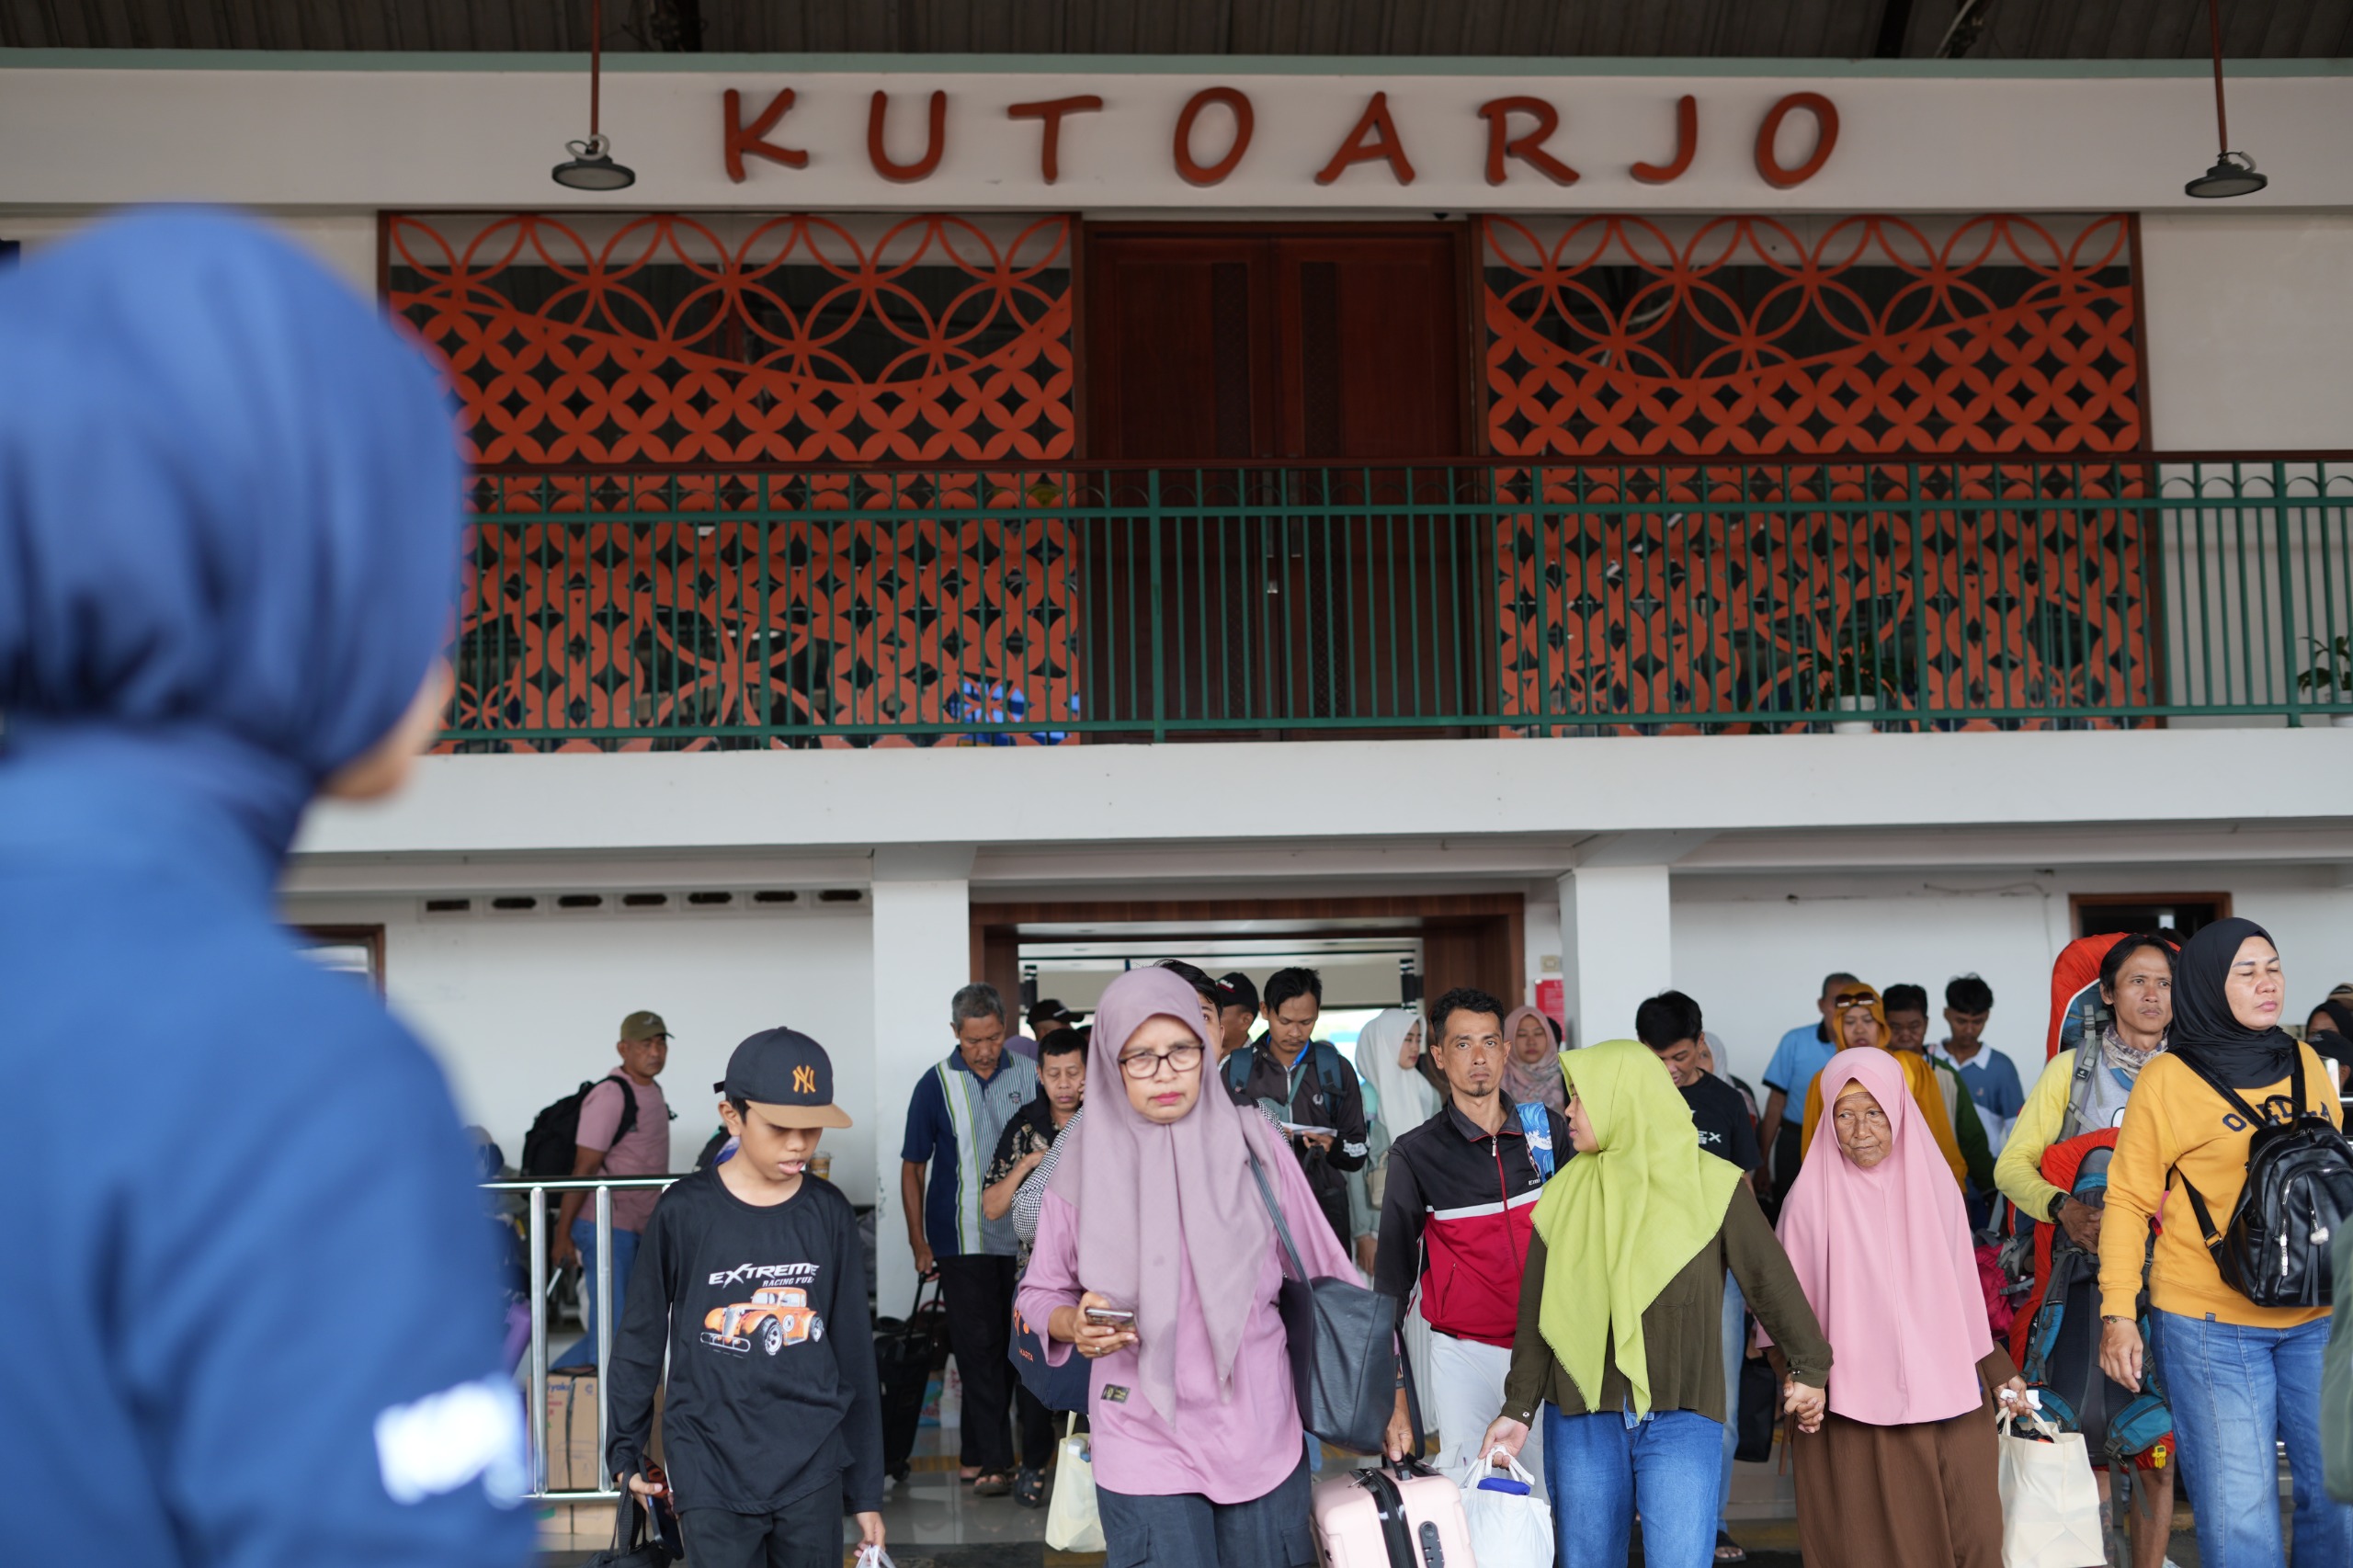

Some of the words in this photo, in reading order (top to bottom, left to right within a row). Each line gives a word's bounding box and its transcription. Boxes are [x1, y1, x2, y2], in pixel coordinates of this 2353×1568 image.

[723, 86, 1839, 187] KUTOARJO
[708, 1263, 820, 1289] EXTREME
[762, 1277, 794, 1288] RACING
